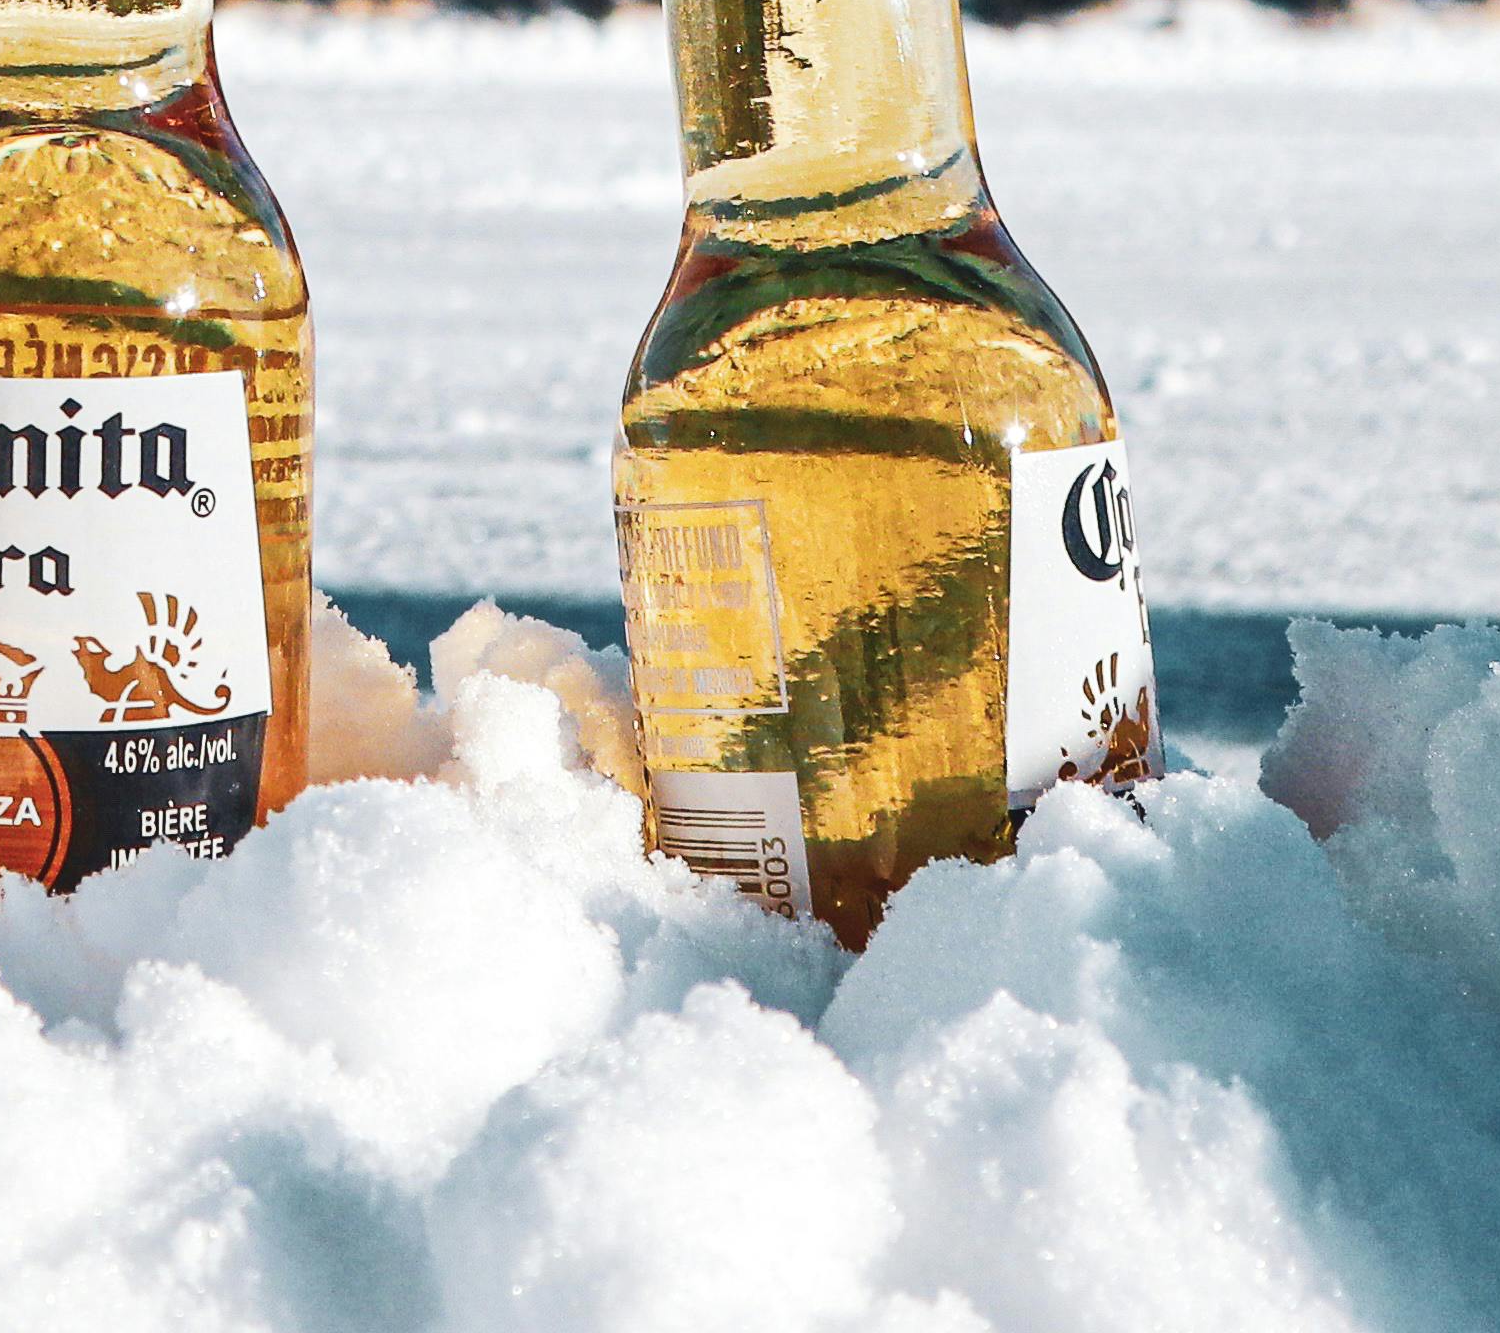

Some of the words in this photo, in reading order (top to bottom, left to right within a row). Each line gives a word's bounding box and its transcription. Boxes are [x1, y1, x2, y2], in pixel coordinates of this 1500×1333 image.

[104, 738, 160, 774] 4.6%
[166, 729, 237, 770] alc./vol.
[141, 799, 208, 838] BIÈRE
